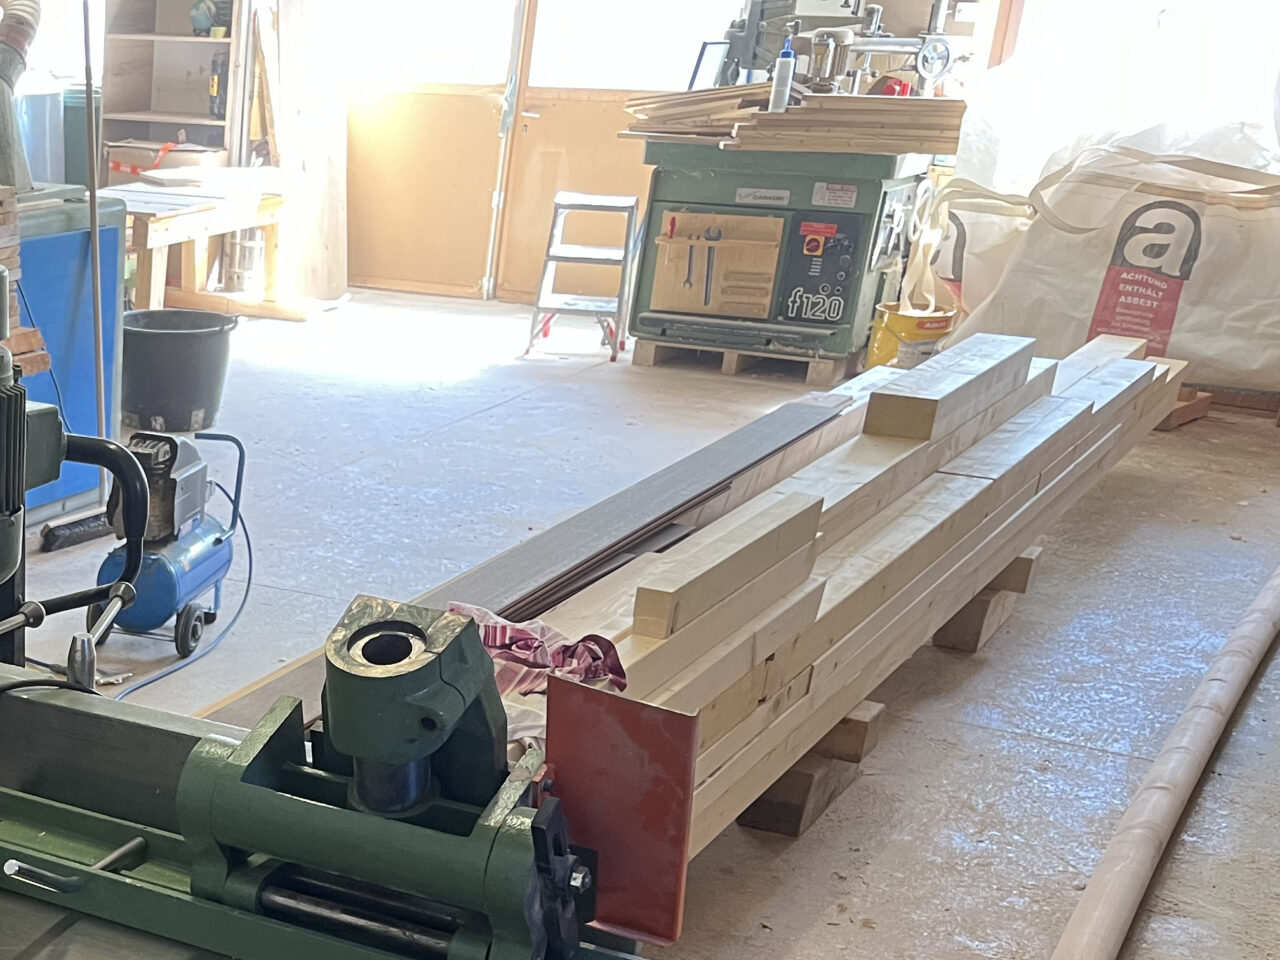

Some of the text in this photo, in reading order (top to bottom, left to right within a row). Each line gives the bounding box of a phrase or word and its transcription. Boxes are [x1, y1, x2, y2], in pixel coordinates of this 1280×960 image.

[1121, 272, 1168, 289] ACHTUNG
[788, 287, 844, 321] f120
[1118, 295, 1160, 309] ASBEST
